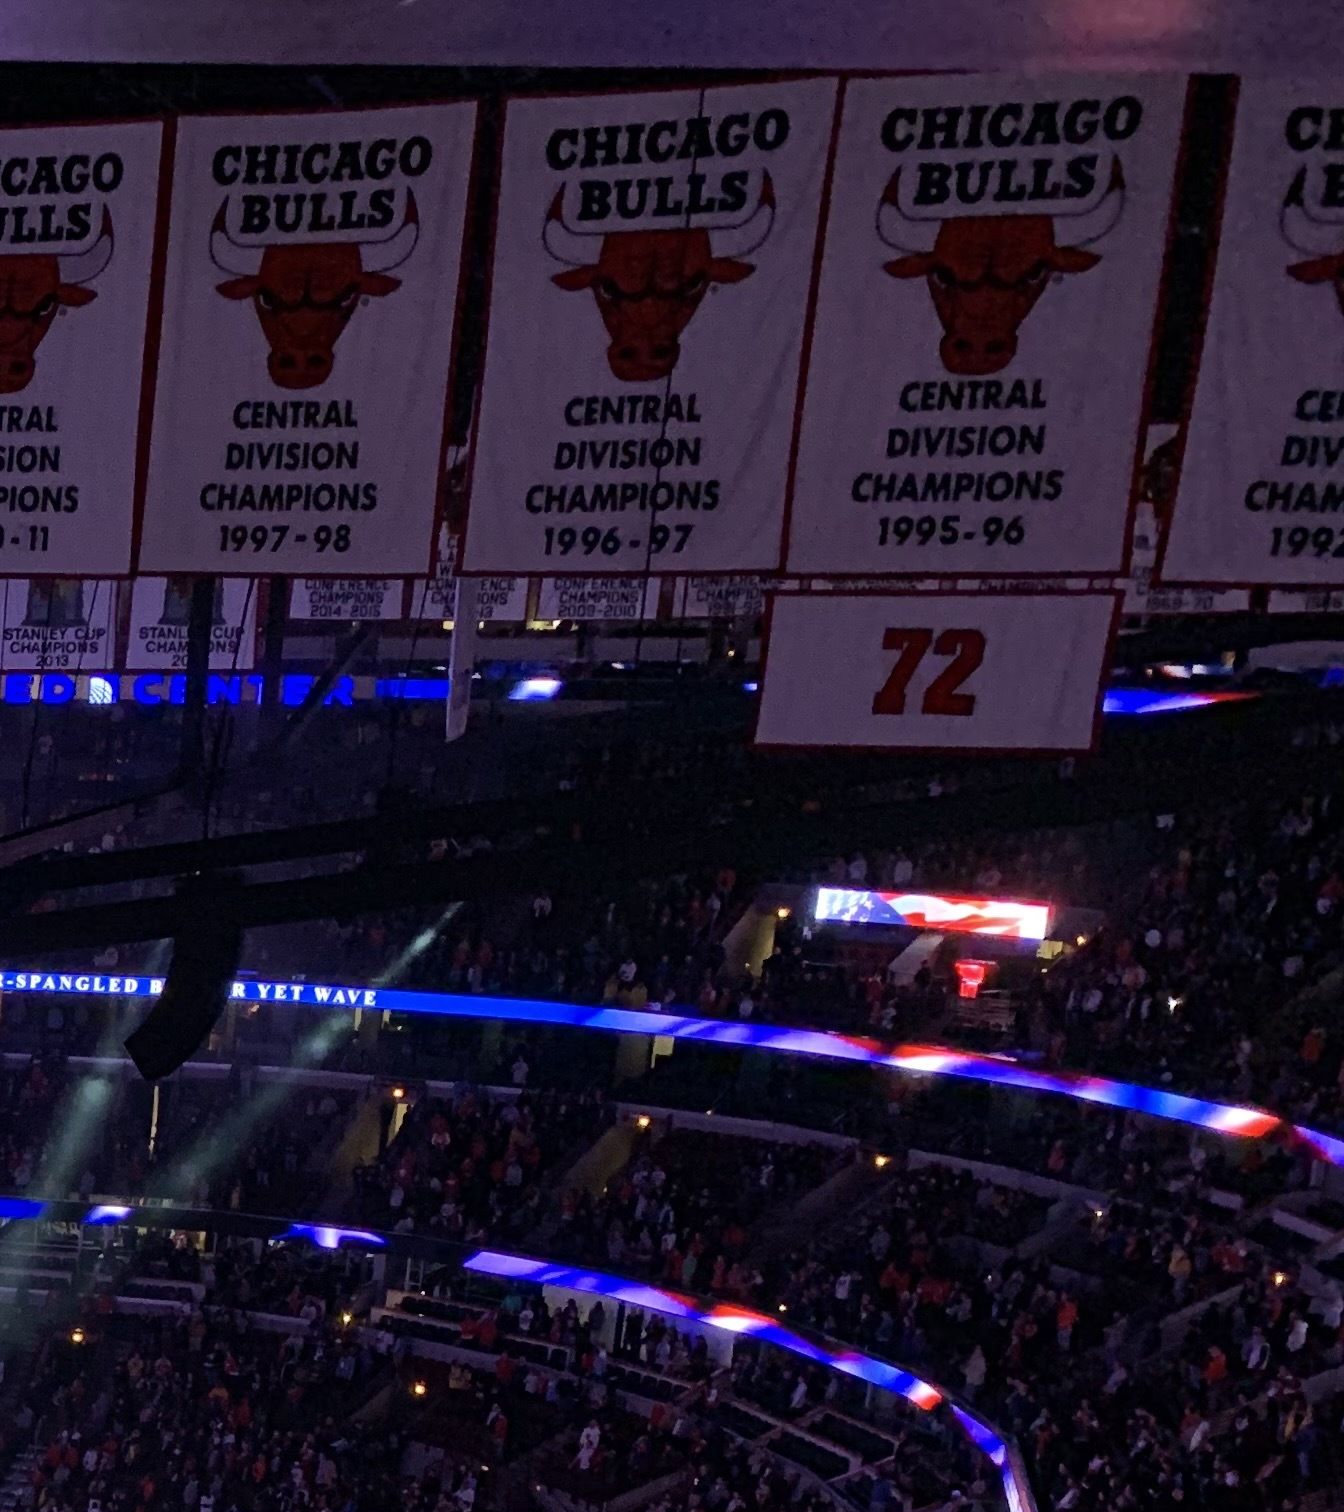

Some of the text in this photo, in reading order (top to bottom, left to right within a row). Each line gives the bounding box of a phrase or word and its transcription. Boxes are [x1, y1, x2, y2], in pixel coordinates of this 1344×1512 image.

[546, 109, 790, 169] CHICAGO
[880, 96, 1143, 152] CHICAGO
[212, 136, 432, 185] CHICAGO
[914, 153, 1098, 206] BULLS
[240, 189, 396, 234] BULLS
[577, 171, 748, 221] BULLS
[564, 394, 701, 427] CENTRAL
[900, 379, 1047, 412] CENTRAL
[232, 400, 358, 429] CENTRAL
[225, 442, 358, 469] DIVISION
[554, 439, 700, 470] DIVISION
[886, 425, 1045, 457] DIVISION
[199, 483, 377, 511] CHAMPIONS
[525, 481, 720, 513] CHAMPIONS
[851, 470, 1064, 503] CHAMPIONS
[309, 592, 385, 604] CHAMPIONS
[310, 605, 381, 618] 2014-2015
[559, 590, 640, 603] CHAMPIONS
[3, 627, 107, 642] STANLEY CUP
[9, 641, 99, 655] CHAMPIONS
[139, 626, 189, 641] STANL
[36, 654, 70, 667] 2013
[872, 628, 986, 716] 72
[257, 983, 303, 1001] YET
[315, 987, 377, 1006] WAVE
